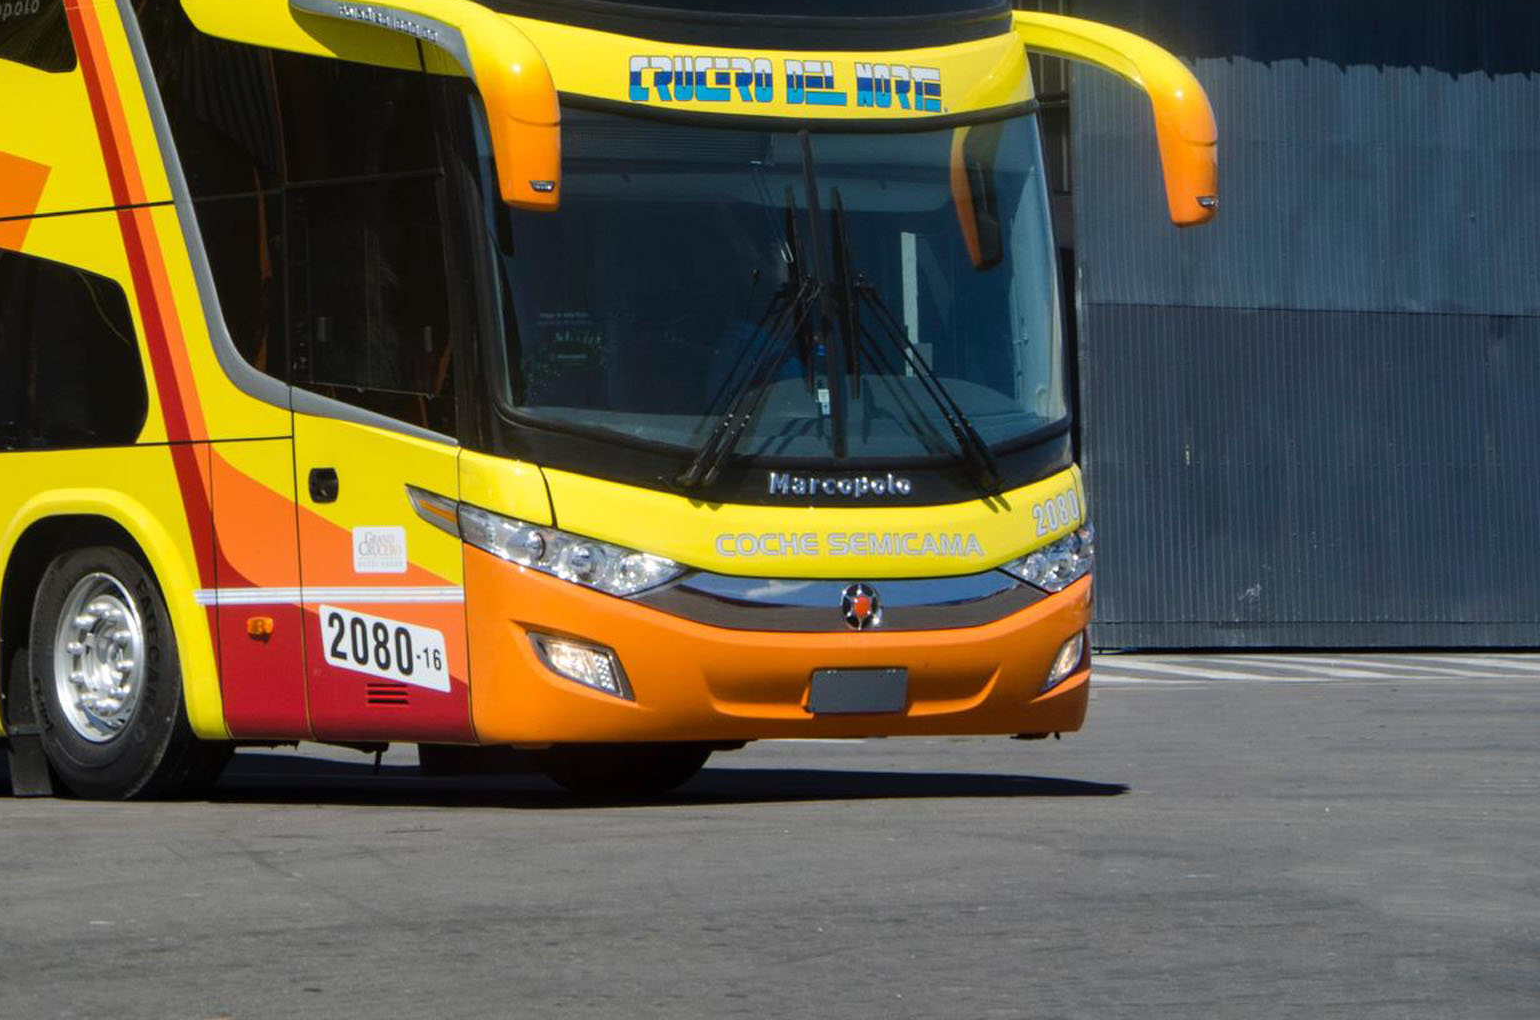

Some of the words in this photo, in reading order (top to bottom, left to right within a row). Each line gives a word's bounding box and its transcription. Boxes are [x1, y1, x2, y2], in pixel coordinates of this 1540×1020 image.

[629, 55, 773, 102] CRUCERO
[784, 60, 847, 107] DEL
[854, 62, 941, 113] NORTE
[769, 472, 910, 497] Marcopolo
[1031, 490, 1081, 537] 2080
[715, 533, 820, 556] COCHE
[829, 532, 984, 556] SEMICAMA
